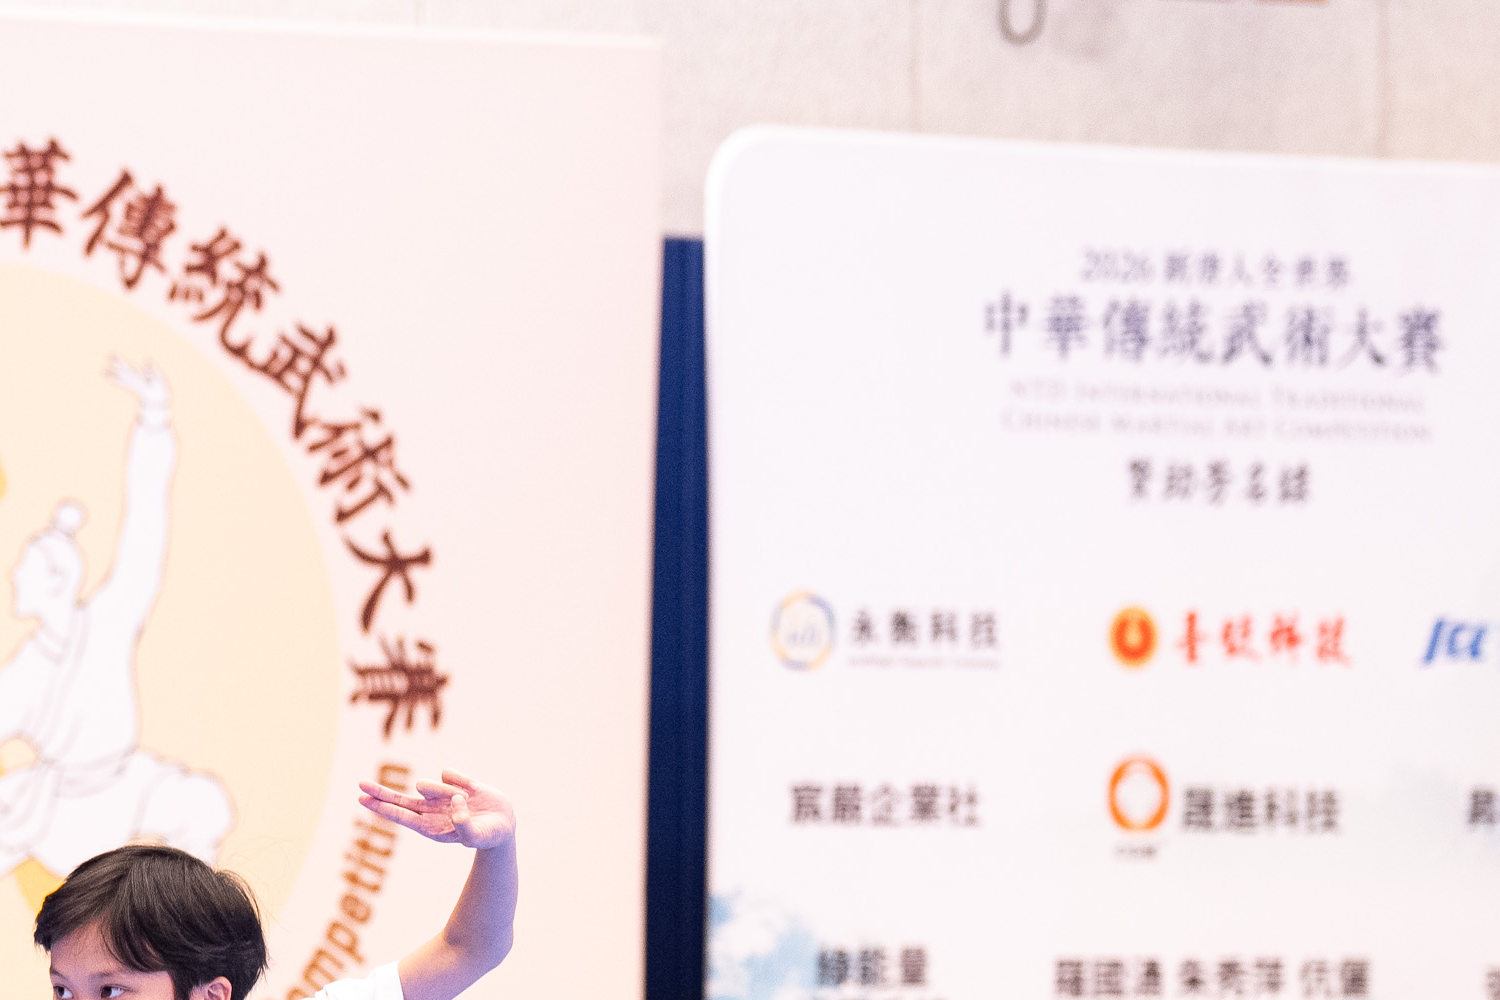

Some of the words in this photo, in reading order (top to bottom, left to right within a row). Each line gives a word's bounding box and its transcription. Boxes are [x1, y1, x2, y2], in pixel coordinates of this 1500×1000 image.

[984, 290, 1445, 373] 中華傳統武術大賽
